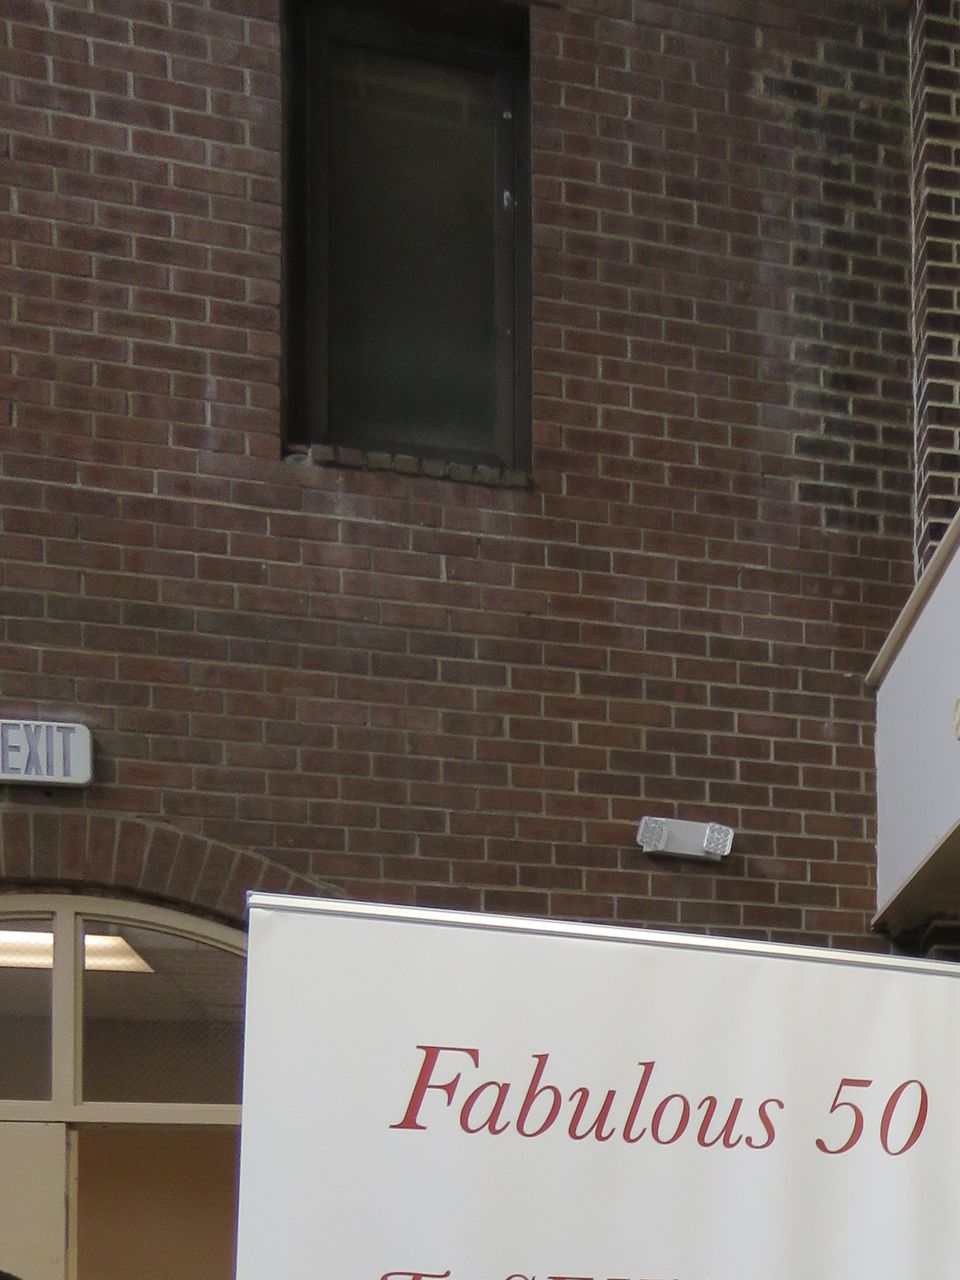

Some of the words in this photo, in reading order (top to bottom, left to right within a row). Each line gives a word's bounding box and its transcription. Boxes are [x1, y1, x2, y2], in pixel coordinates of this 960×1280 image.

[1, 722, 77, 777] EXIT
[389, 1045, 785, 1149] Fabulous
[816, 1077, 930, 1155] 50
